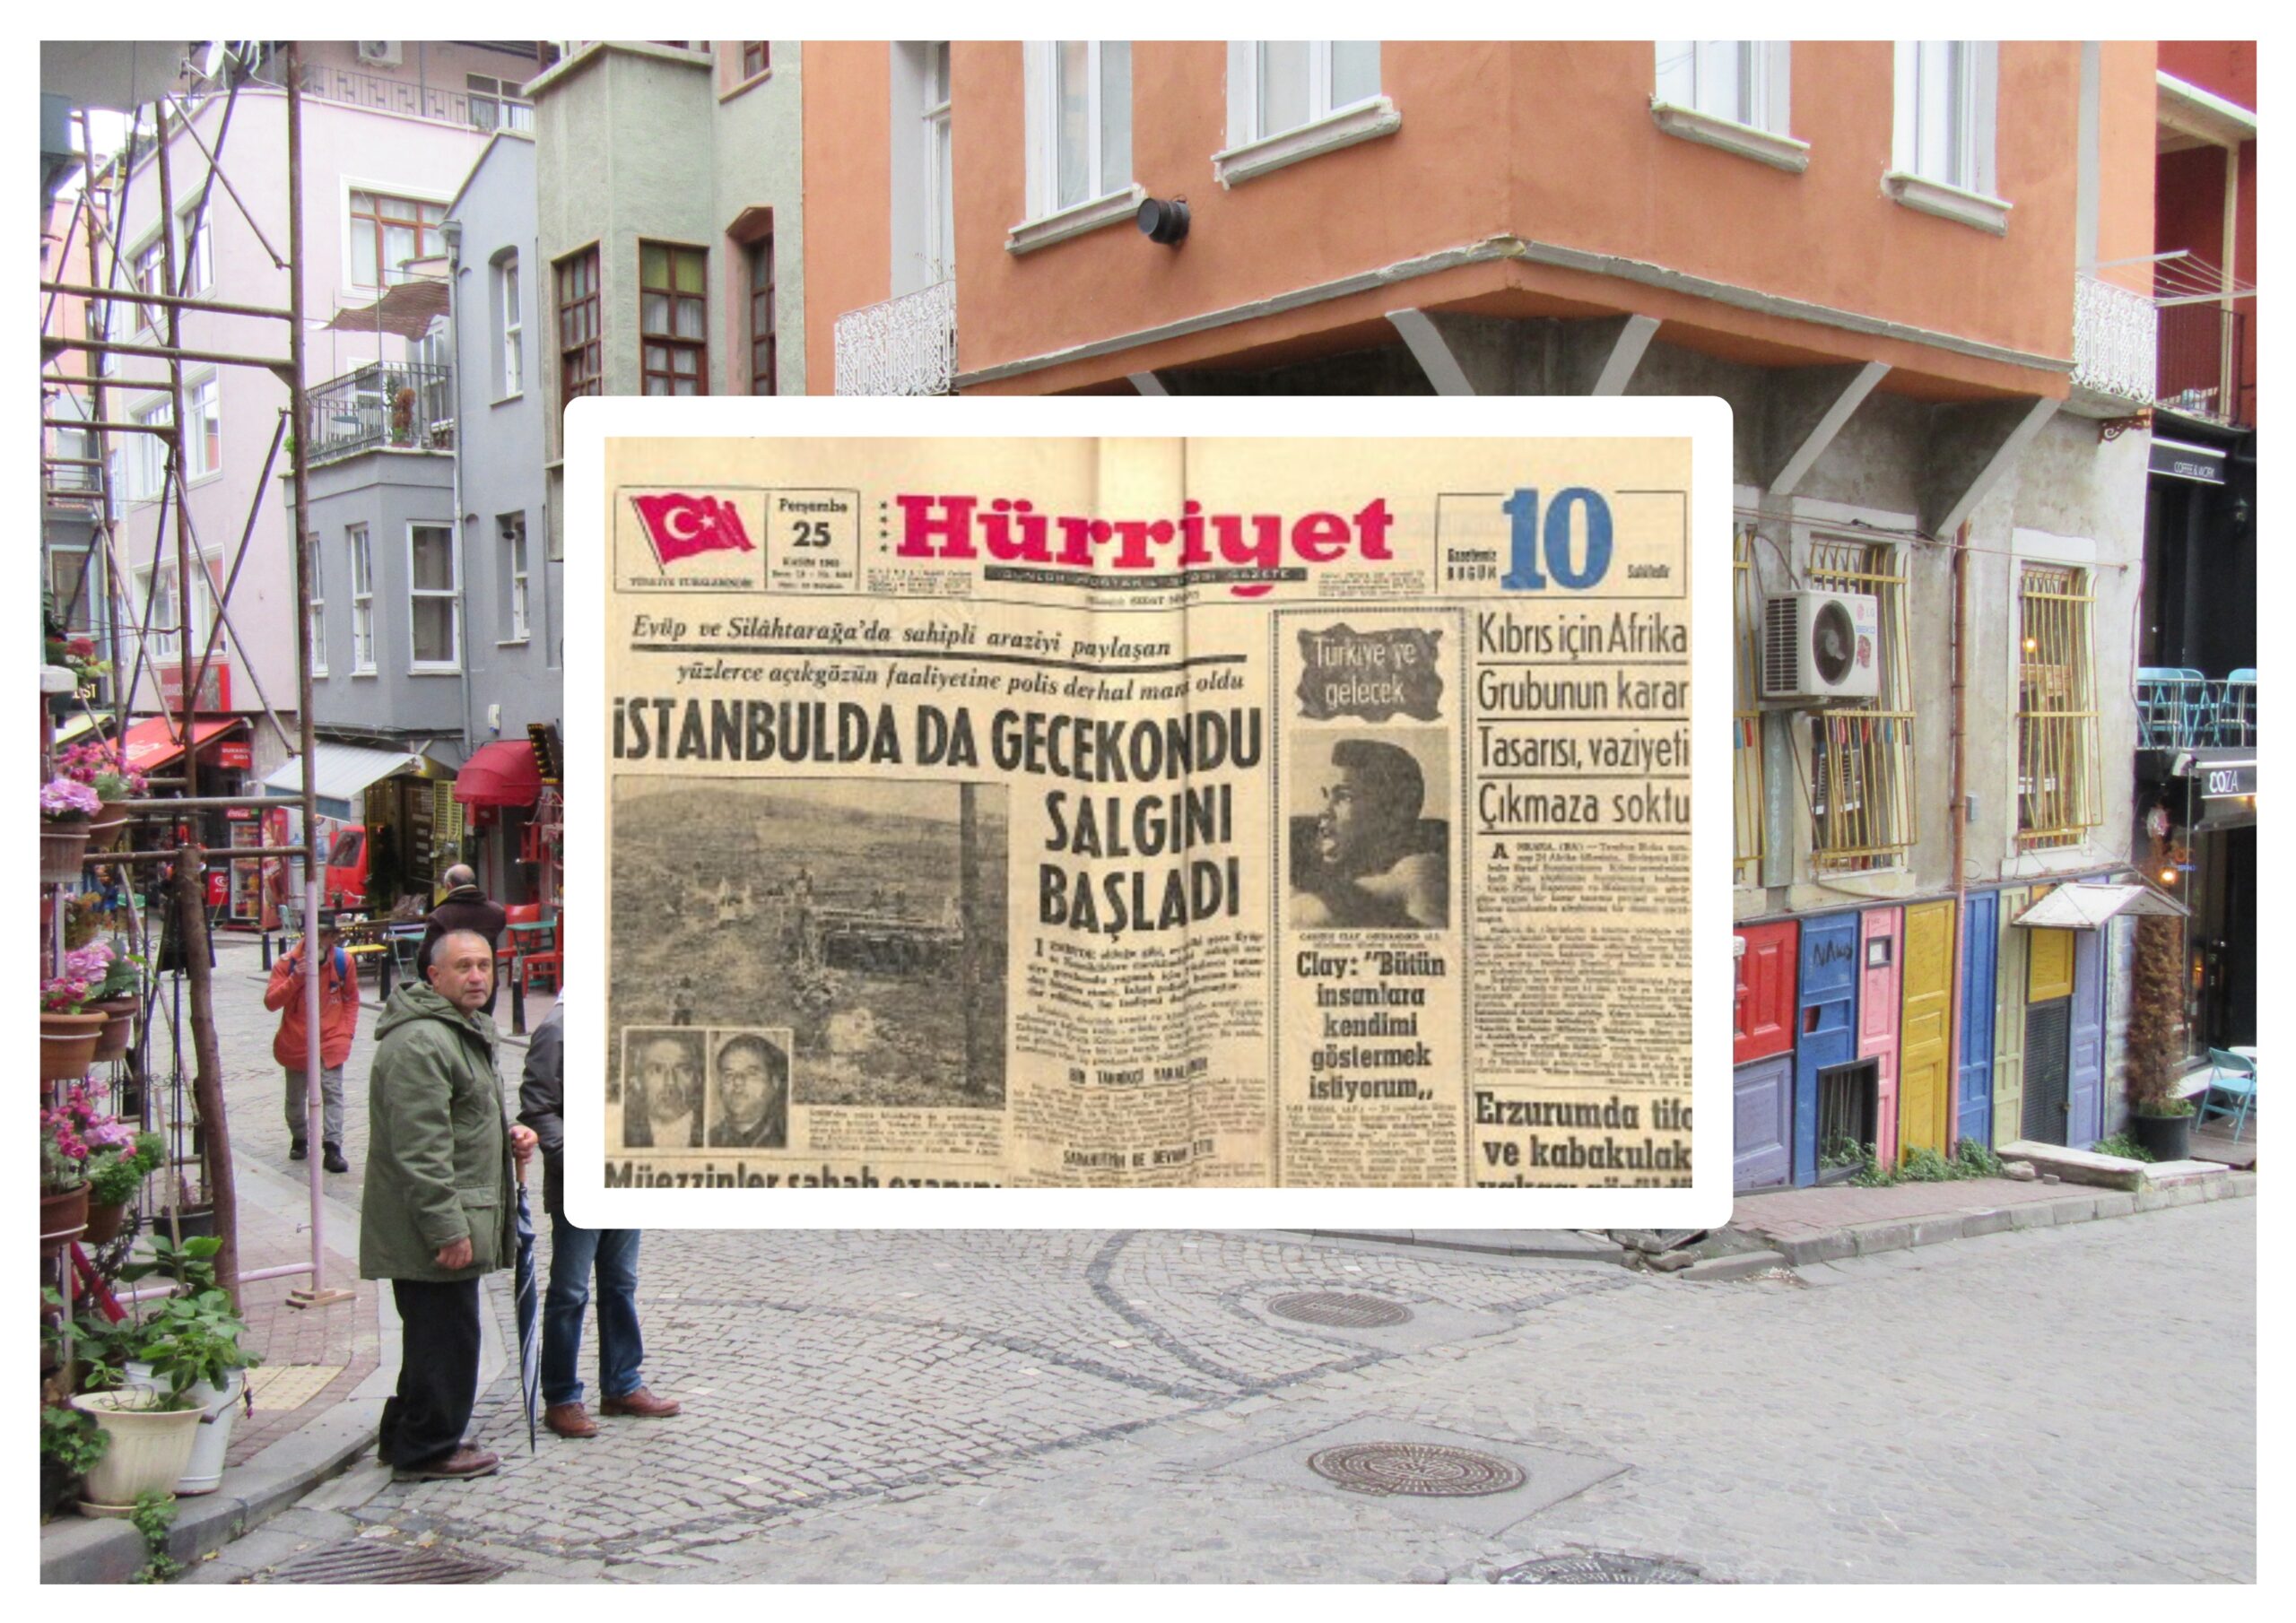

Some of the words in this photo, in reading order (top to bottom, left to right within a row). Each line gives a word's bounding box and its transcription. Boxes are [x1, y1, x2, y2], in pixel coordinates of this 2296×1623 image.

[778, 498, 848, 516] Perşembe
[792, 521, 831, 548] 25
[896, 495, 1394, 597] Hürriyet
[1500, 487, 1613, 591] 10
[631, 613, 688, 642] Eyüp
[700, 621, 721, 638] ve
[901, 621, 978, 649] sahipli
[987, 629, 1063, 653] araziyi
[1071, 636, 1171, 664] paylaşan
[1312, 633, 1417, 671] Türkiye'ye
[1478, 612, 1552, 654] Kıbrıs
[1558, 613, 1603, 660] için
[1606, 612, 1688, 653] Afrika
[676, 659, 763, 685] yüzlerce
[769, 660, 879, 688] açıkgözün
[884, 663, 1001, 690] faaliyetine
[1006, 672, 1058, 696] polis
[1063, 676, 1135, 702] derhal
[1196, 665, 1246, 692] oldu
[1325, 674, 1405, 711] gelecek
[1477, 669, 1608, 711] Grubunun
[1617, 669, 1690, 711] karar
[613, 696, 902, 765] İSTANBULDA
[915, 706, 978, 768] DA
[991, 707, 1261, 784] GECEKONDU
[1477, 725, 1582, 769] Tasarısı,
[1587, 728, 1690, 772] vaziyeti
[2208, 770, 2240, 794] COZA
[1044, 783, 1233, 858] SALGINI
[1478, 781, 1598, 830] Çıkmaza
[1611, 782, 1691, 823] soktu
[1039, 856, 1239, 943] BAŞLADI
[1297, 950, 1359, 979] Clay:
[1317, 982, 1426, 1008] insanlara
[1323, 1011, 1419, 1038] kendimi
[1310, 1041, 1432, 1072] göstermek
[1474, 1090, 1640, 1130] Erzurumda
[1482, 1141, 1520, 1167] ve
[1529, 1134, 1692, 1169] kabakulak
